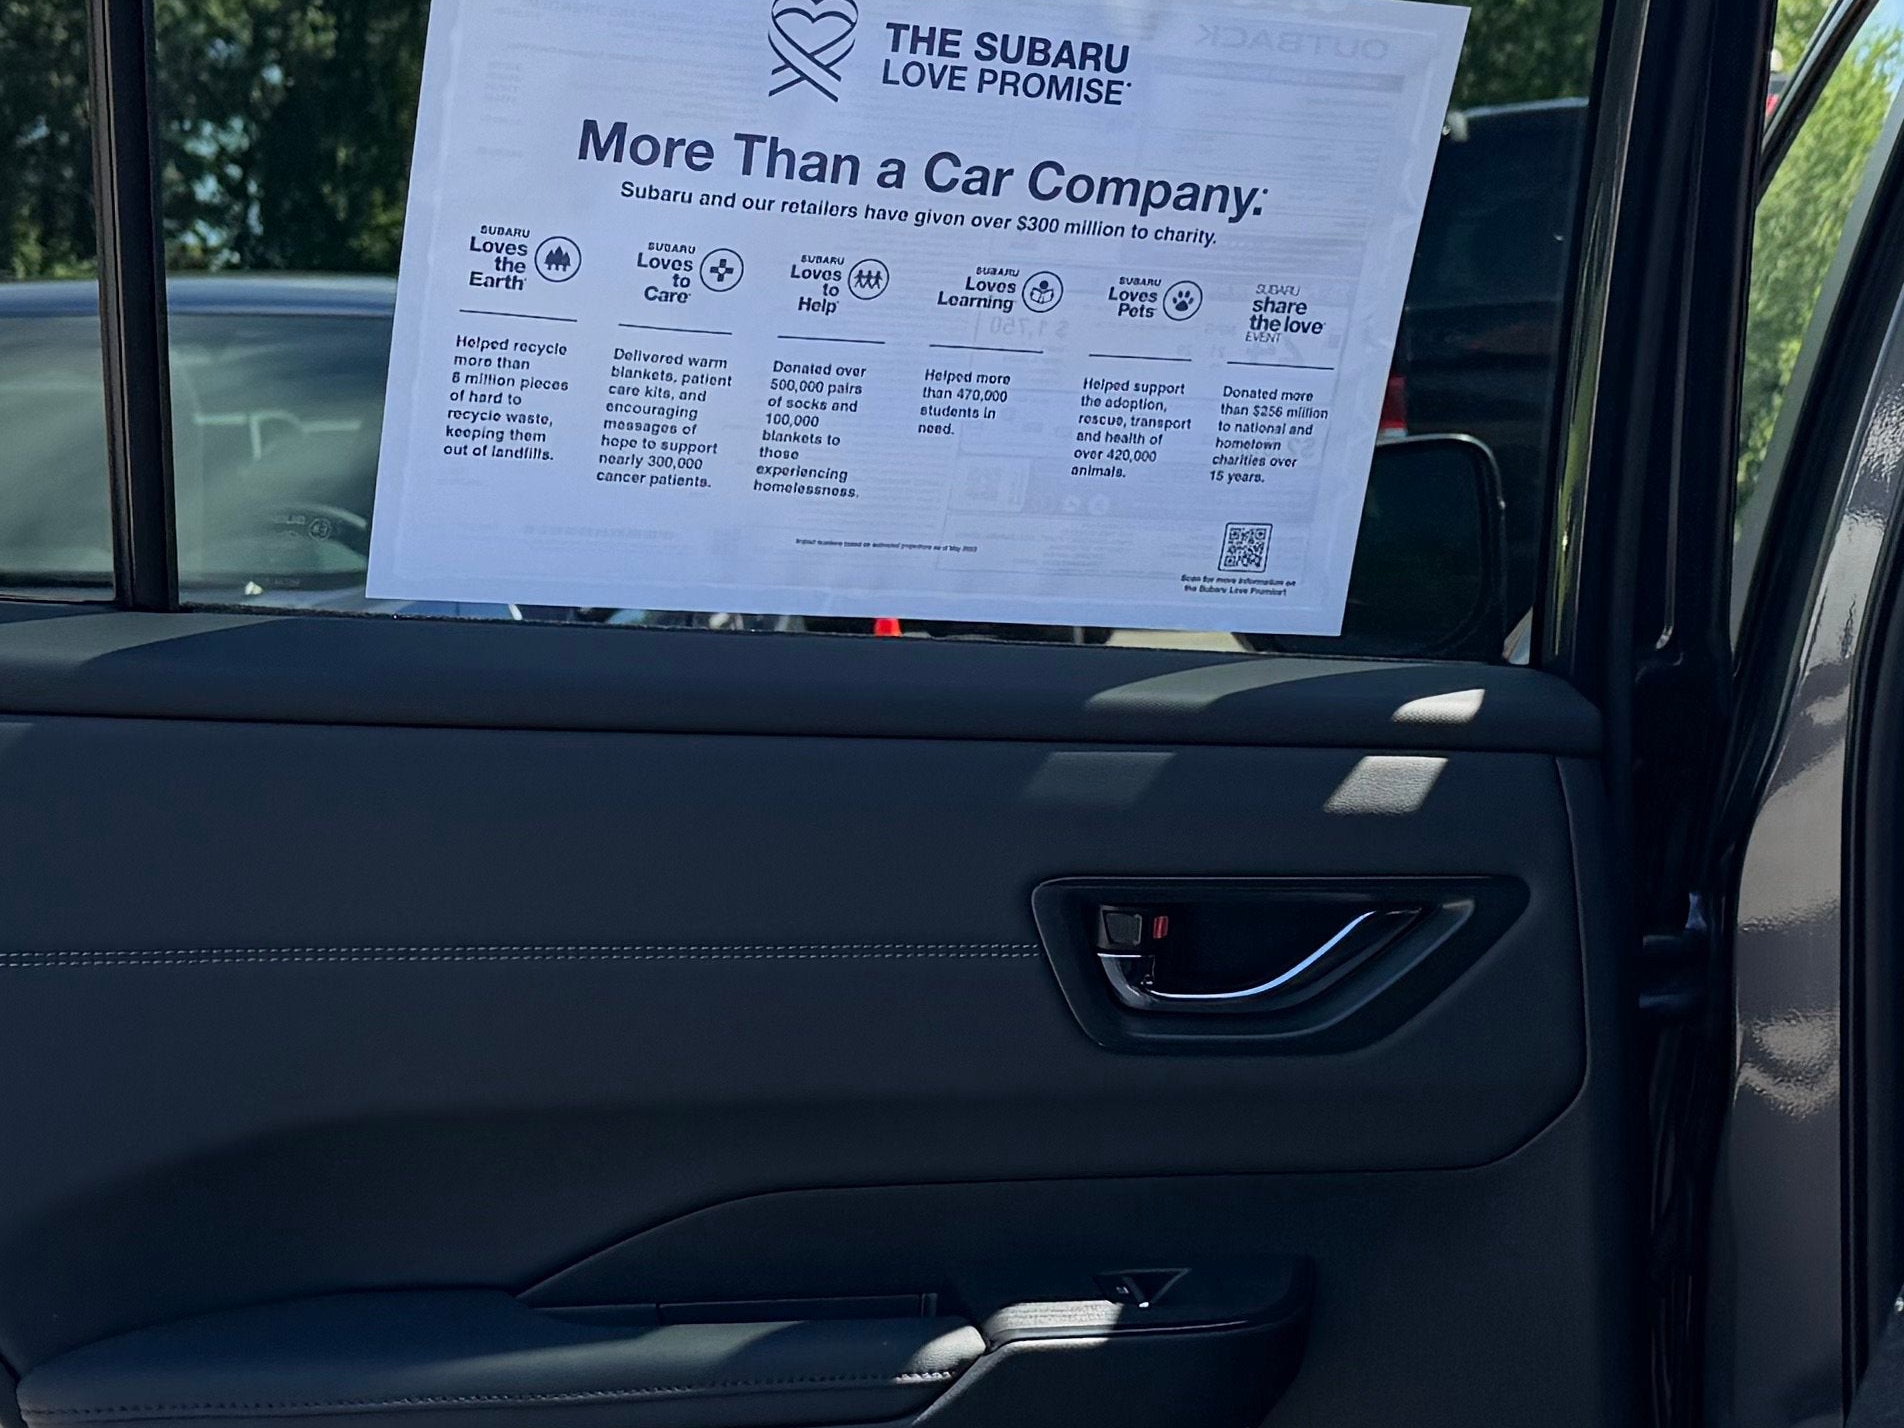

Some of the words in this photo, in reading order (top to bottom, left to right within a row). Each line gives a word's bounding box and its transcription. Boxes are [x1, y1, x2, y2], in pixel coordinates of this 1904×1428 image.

[885, 21, 962, 58] THE
[973, 31, 1129, 74] SUBARU
[882, 58, 968, 91] LOVE
[577, 118, 714, 171] More
[733, 132, 860, 185] Than
[876, 158, 905, 189] a
[924, 151, 1014, 196] Car
[1028, 160, 1268, 223] Company.
[620, 180, 692, 204] Subaru
[698, 192, 736, 208] and
[741, 197, 775, 211] our
[780, 199, 861, 218] retailers
[863, 203, 908, 221] have
[913, 208, 964, 227] given
[970, 215, 1012, 229] over
[1016, 215, 1059, 233] $300
[1063, 219, 1125, 237] million
[1130, 223, 1148, 239] to
[1153, 225, 1216, 248] charity.
[479, 224, 530, 238] SUBARU
[469, 235, 528, 256] Loves
[647, 241, 695, 254] SUBARU
[493, 255, 526, 273] the
[636, 251, 693, 272] Loves
[800, 254, 845, 265] SUBARU
[790, 263, 841, 281] Loves
[975, 266, 1020, 277] SUBARU
[468, 271, 523, 290] Earth
[671, 273, 690, 288] to
[822, 282, 839, 296] to
[964, 275, 1016, 293] Loves
[1118, 276, 1161, 286] SUBARU
[643, 285, 688, 303] Care
[1107, 285, 1157, 303] Loves
[1255, 283, 1301, 297] SUBARU
[797, 295, 836, 316] Help
[936, 290, 1014, 313] Learning
[1117, 302, 1155, 318] Pets
[1251, 295, 1307, 315] share
[1248, 313, 1281, 333] the
[1283, 315, 1323, 334] love
[455, 334, 509, 352] Helped
[513, 342, 567, 356] recycle
[1244, 330, 1283, 343] EVENT
[453, 355, 492, 367] more
[496, 356, 530, 370] than
[613, 347, 684, 365] Delivered
[687, 356, 727, 369] warm
[610, 365, 677, 383] blankets,
[680, 372, 731, 386] patient
[772, 359, 832, 375] Donated
[835, 366, 866, 377] over
[924, 368, 972, 385] Helped
[975, 373, 1010, 385] more
[464, 372, 515, 386] million
[519, 376, 568, 391] pieces
[769, 377, 824, 393] 500,000
[826, 381, 862, 396] pairs
[1082, 377, 1130, 394] Helped
[1132, 382, 1184, 397] support
[449, 388, 465, 402] of
[468, 389, 503, 404] hard
[507, 393, 521, 405] to
[608, 385, 640, 396] care
[644, 384, 674, 401] kits,
[678, 389, 706, 402] and
[922, 386, 952, 399] than
[956, 387, 1007, 402] 470,000
[1222, 385, 1278, 400] Donated
[1280, 391, 1313, 401] more
[605, 402, 698, 421] encouraging
[767, 395, 782, 407] of
[785, 397, 827, 410] socks
[831, 399, 858, 412] and
[919, 404, 979, 418] students
[983, 405, 996, 419] in
[1080, 393, 1101, 407] the
[1104, 395, 1167, 413] adoption,
[1220, 402, 1248, 416] than
[1286, 406, 1328, 419] million
[447, 409, 501, 423] recycle
[505, 412, 552, 427] waste,
[765, 412, 819, 428] 100,000
[1077, 414, 1126, 429] rescue,
[1130, 414, 1191, 431] transport
[445, 424, 504, 443] keeping
[509, 428, 546, 442] them
[603, 419, 677, 435] messages
[681, 423, 697, 435] of
[917, 422, 954, 435] need.
[1218, 419, 1231, 432] to
[1234, 421, 1286, 434] national
[1288, 423, 1313, 435] and
[600, 433, 637, 450] hope
[642, 437, 656, 449] to
[660, 440, 717, 455] support
[761, 428, 822, 444] blankets
[826, 434, 840, 446] to
[1076, 430, 1101, 442] and
[1104, 430, 1145, 444] health
[1148, 433, 1163, 445] of
[1215, 436, 1281, 450] hometown
[443, 444, 468, 456] out
[471, 444, 487, 456] of
[491, 444, 553, 460] landfills.
[759, 445, 799, 460] those
[1073, 448, 1103, 460] over
[1106, 448, 1157, 463] 420,000
[1211, 453, 1266, 466] charities
[1269, 457, 1297, 467] over
[598, 453, 643, 469] nearly
[647, 454, 703, 470] 300,000
[596, 471, 646, 483] cancer
[648, 473, 711, 487] patients.
[755, 464, 848, 483] experiencing
[1070, 464, 1126, 478] animals.
[1209, 469, 1224, 481] 15
[1226, 472, 1264, 484] years.
